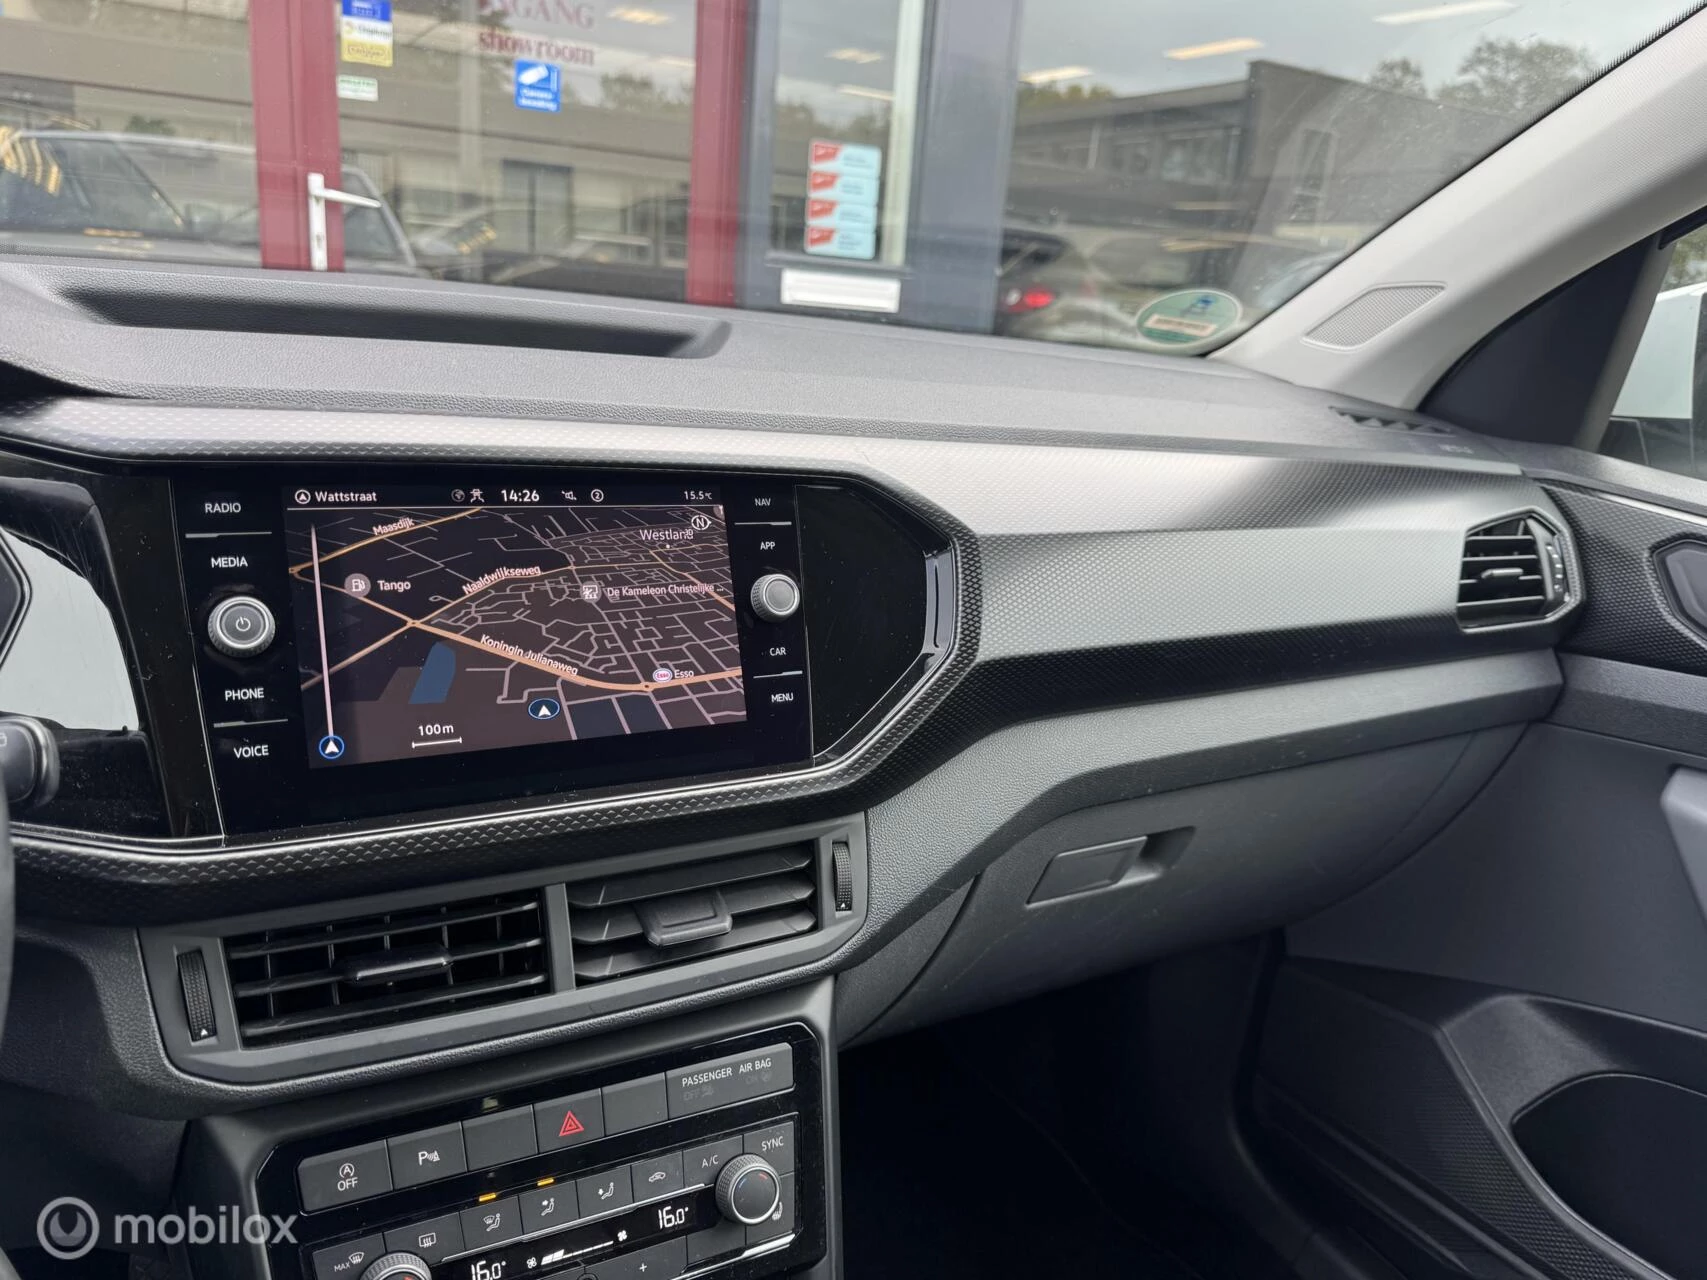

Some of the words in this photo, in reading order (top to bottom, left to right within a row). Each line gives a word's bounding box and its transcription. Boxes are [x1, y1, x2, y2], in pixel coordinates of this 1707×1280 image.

[479, 27, 595, 66] showroom
[314, 491, 377, 502] Wattstraat
[501, 489, 540, 502] 14:26
[754, 497, 771, 507] NAV
[204, 502, 242, 514] RADIO
[372, 517, 415, 535] Maasdijk
[760, 541, 776, 551] APP
[210, 555, 249, 569] MEDIA
[376, 579, 412, 593] Tango
[462, 566, 541, 595] Naaldwijkseweg
[607, 587, 620, 597] De
[622, 586, 667, 597] Kameleon
[668, 583, 715, 594] Christelijke
[480, 633, 524, 659] Koningin
[524, 651, 579, 676] Julianaweg
[769, 646, 787, 657] CAR
[674, 669, 695, 679] Esso
[224, 687, 265, 702] PHONE
[770, 692, 794, 703] MENU
[233, 744, 270, 759] VOICE
[681, 1067, 733, 1088] PASSENGER
[738, 1062, 753, 1075] AIR
[754, 1057, 772, 1071] BAG
[761, 1135, 784, 1151] SYNC
[701, 1154, 719, 1168] A/C
[337, 1176, 359, 1192] OFF
[333, 1261, 351, 1273] MAX
